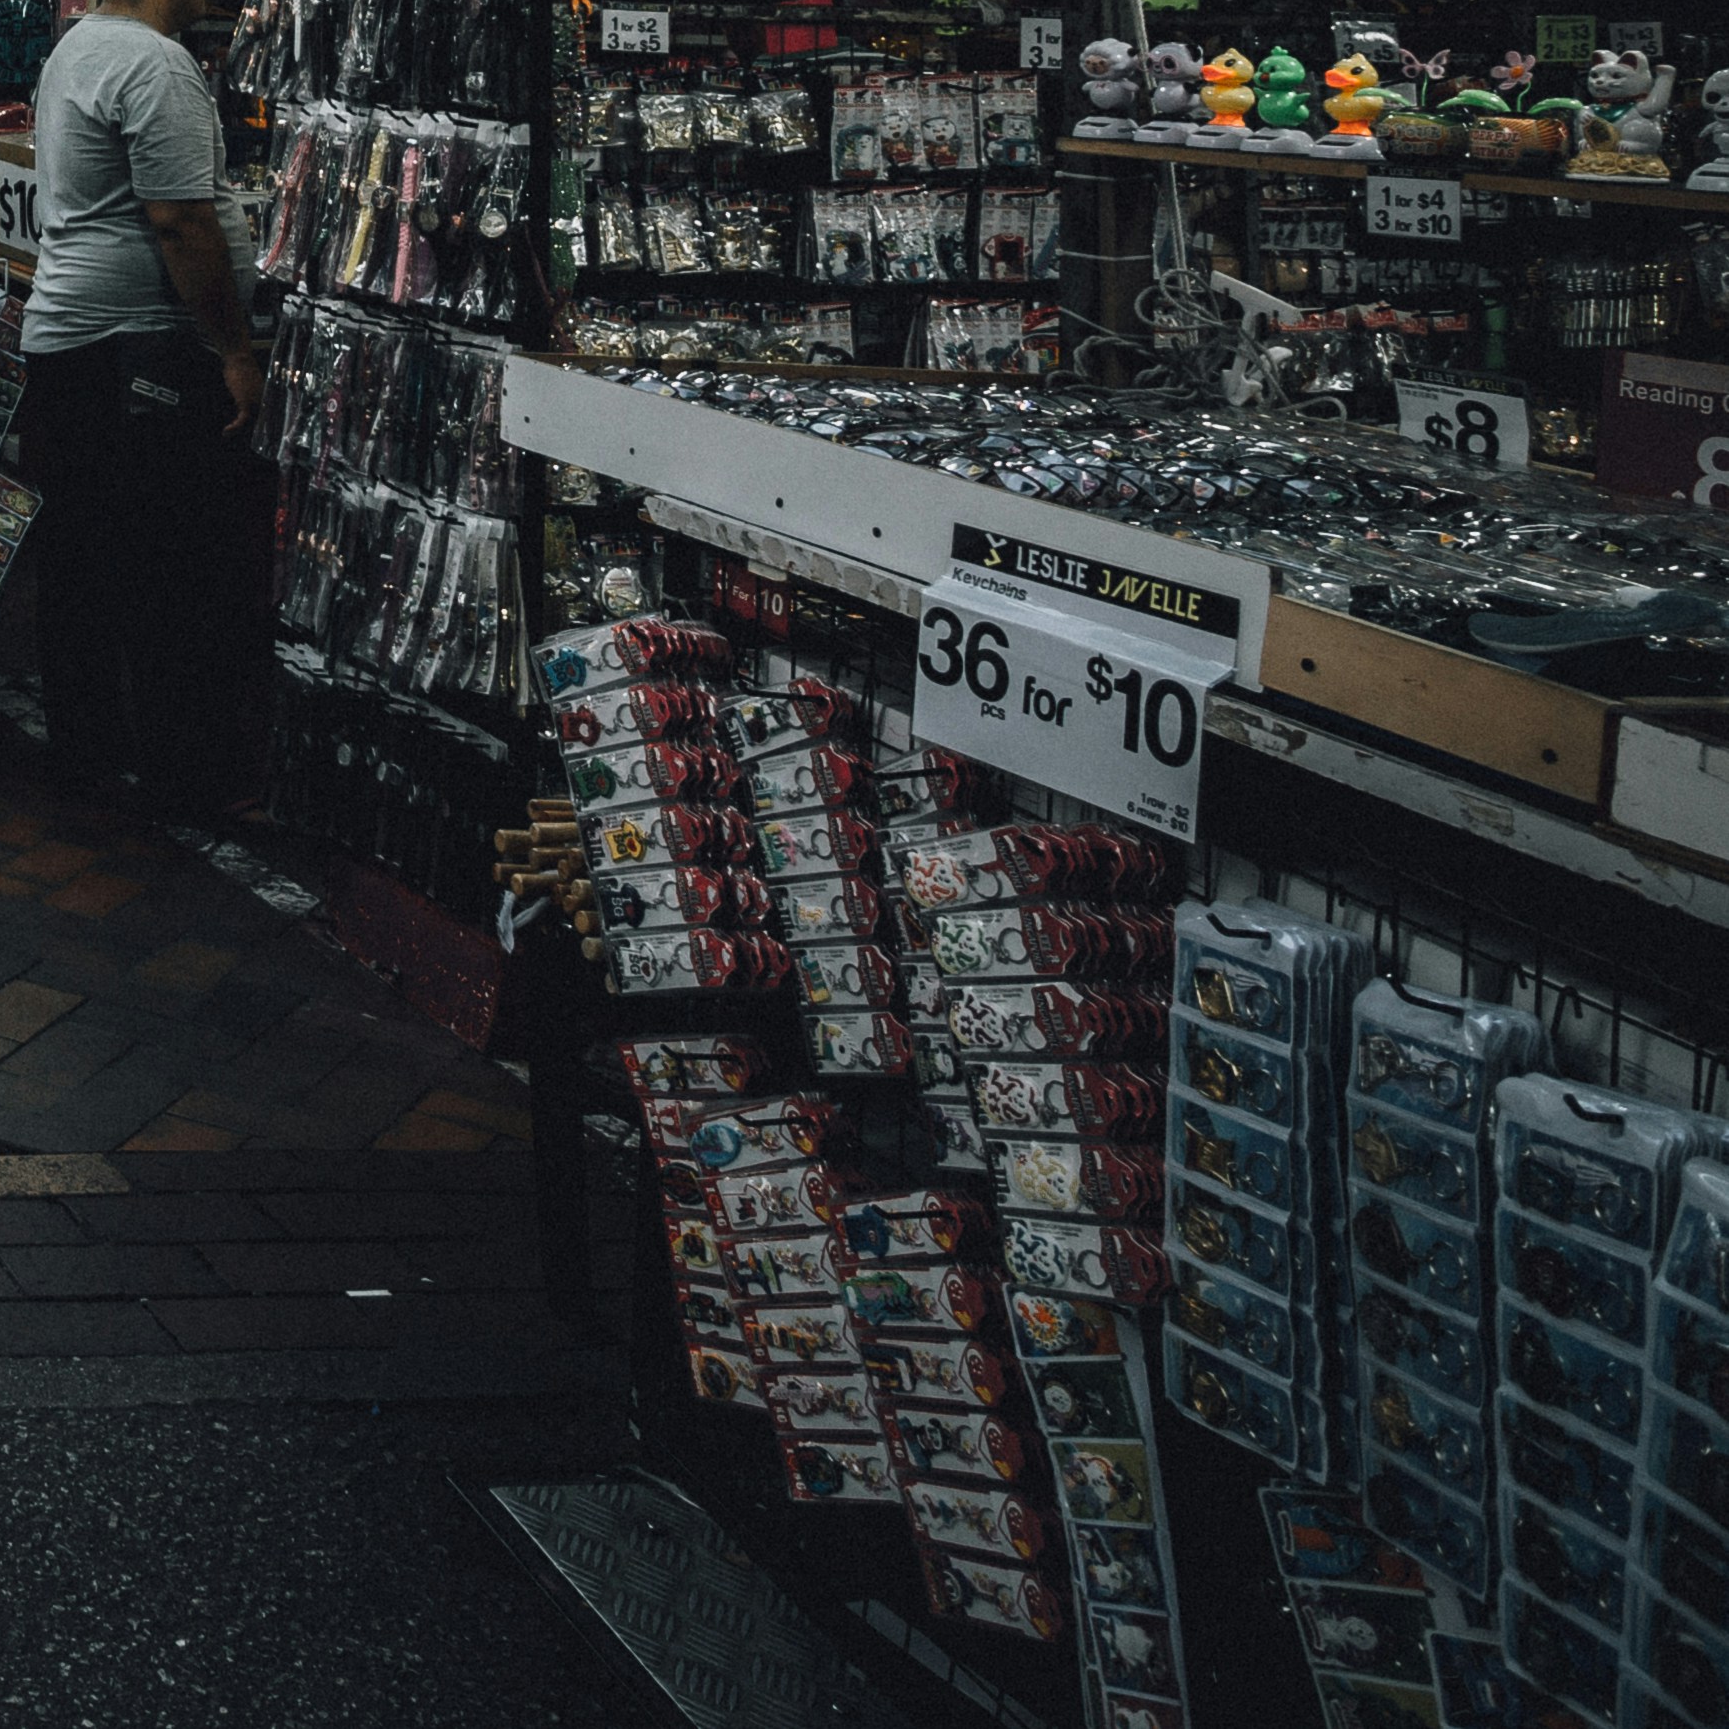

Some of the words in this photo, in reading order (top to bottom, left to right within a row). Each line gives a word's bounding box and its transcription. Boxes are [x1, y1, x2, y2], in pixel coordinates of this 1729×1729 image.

[611, 17, 619, 33] 1
[621, 23, 634, 34] for
[637, 17, 658, 34] $2
[1033, 26, 1043, 44] 1
[1572, 24, 1589, 40] $3
[608, 33, 621, 51] 3
[622, 40, 637, 51] for
[639, 35, 661, 52] $5
[1544, 43, 1554, 57] 2
[1029, 46, 1044, 68] 3
[1381, 186, 1390, 205] 1
[1395, 193, 1413, 207] for
[1417, 189, 1445, 211] $4
[1374, 210, 1389, 230] 3
[1394, 219, 1413, 232] for
[1417, 214, 1452, 236] $10
[1619, 378, 1714, 415] Reading
[951, 566, 1028, 602] Keychains
[1016, 545, 1089, 590] LESLIE
[1097, 569, 1203, 622] JAVELLE
[918, 606, 1010, 703] 36
[1022, 675, 1073, 727] for
[1085, 653, 1198, 768] $10
[980, 702, 1006, 721] pcs
